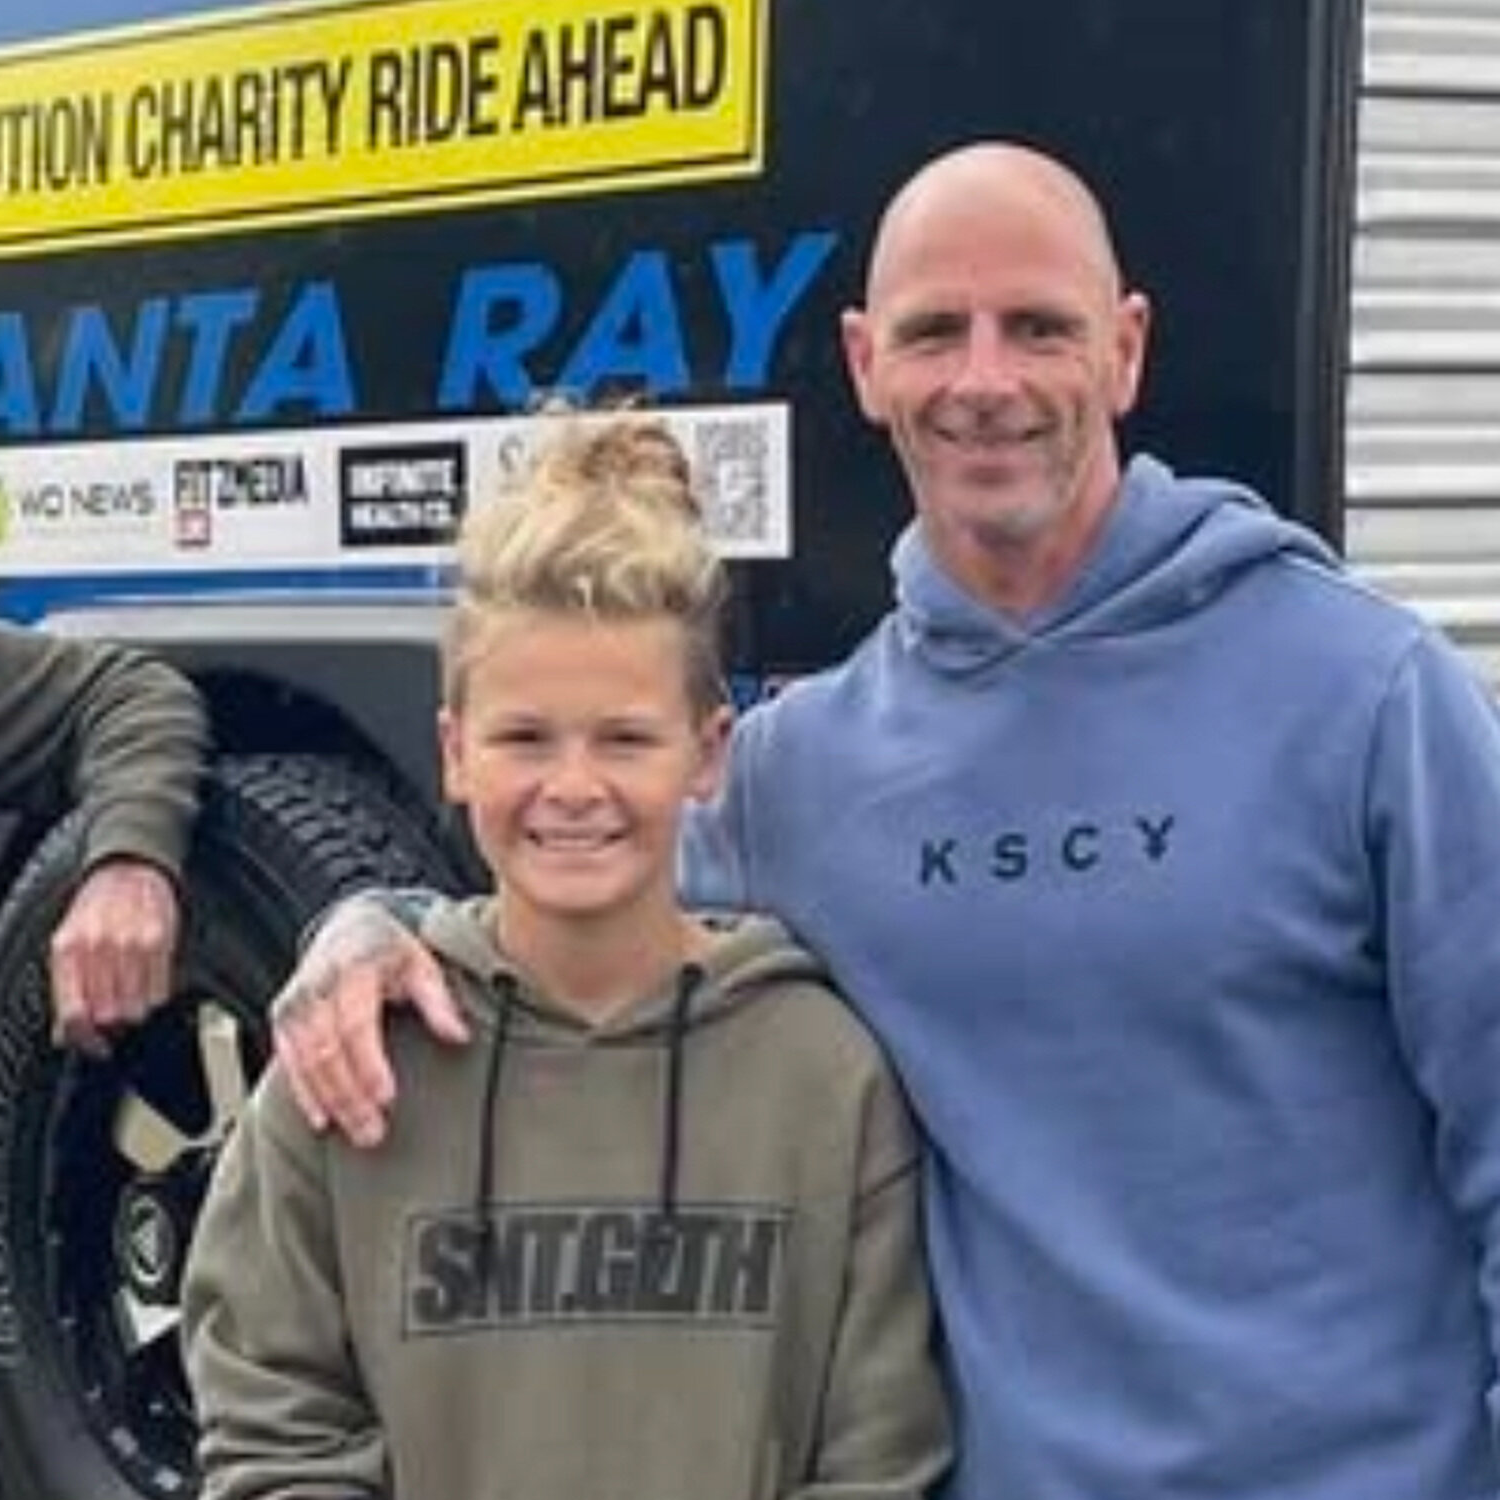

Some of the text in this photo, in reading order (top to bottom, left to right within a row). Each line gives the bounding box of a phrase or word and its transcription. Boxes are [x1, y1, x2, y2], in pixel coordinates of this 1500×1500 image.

[125, 57, 352, 179] CHARITY
[369, 36, 500, 150] RIDE
[511, 6, 727, 131] AHEAD
[436, 231, 839, 412] RAY
